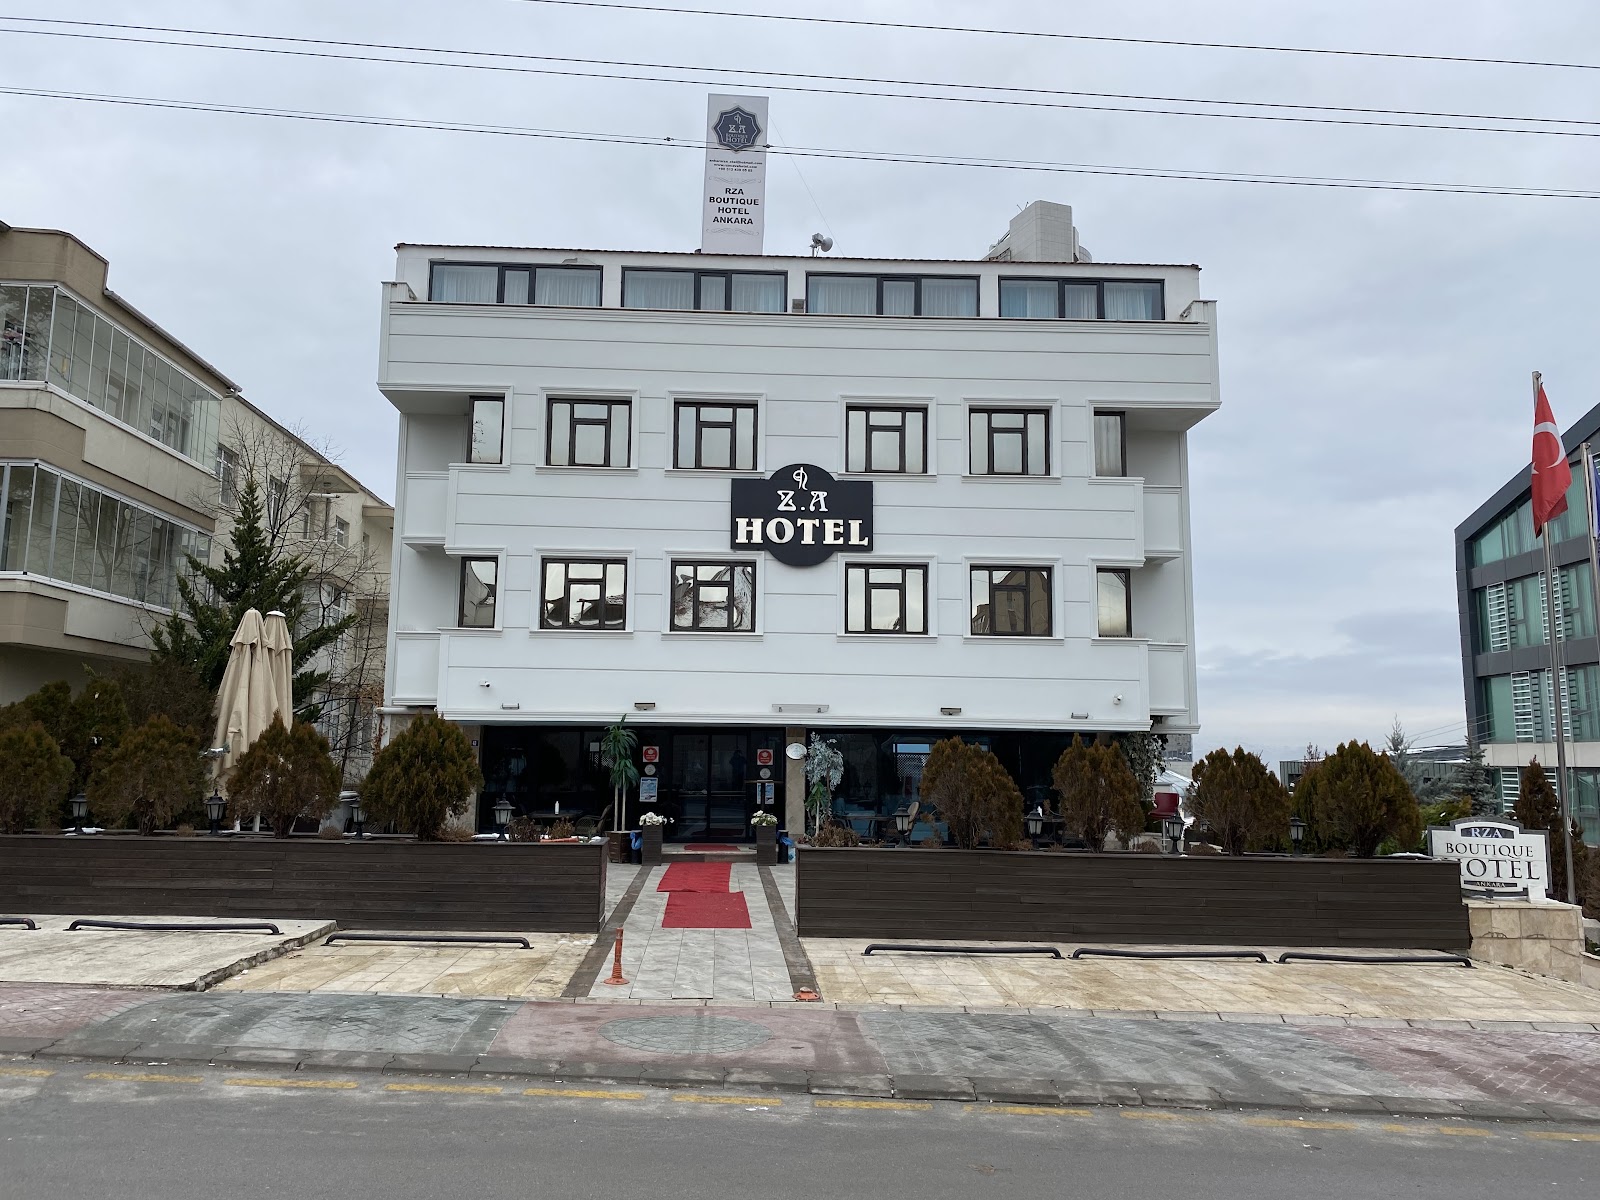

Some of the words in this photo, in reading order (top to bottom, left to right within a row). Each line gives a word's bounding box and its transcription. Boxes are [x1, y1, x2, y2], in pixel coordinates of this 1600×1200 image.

[725, 187, 744, 195] RZA
[709, 196, 760, 206] BOUTIQUE
[717, 206, 750, 215] HOTEL
[712, 216, 754, 225] ANKARA
[735, 517, 869, 546] HOTEL
[1471, 827, 1503, 838] RZA
[1446, 842, 1534, 859] BOUTIQUE
[1460, 858, 1541, 880] OTEL
[1475, 881, 1506, 889] ANKARA
